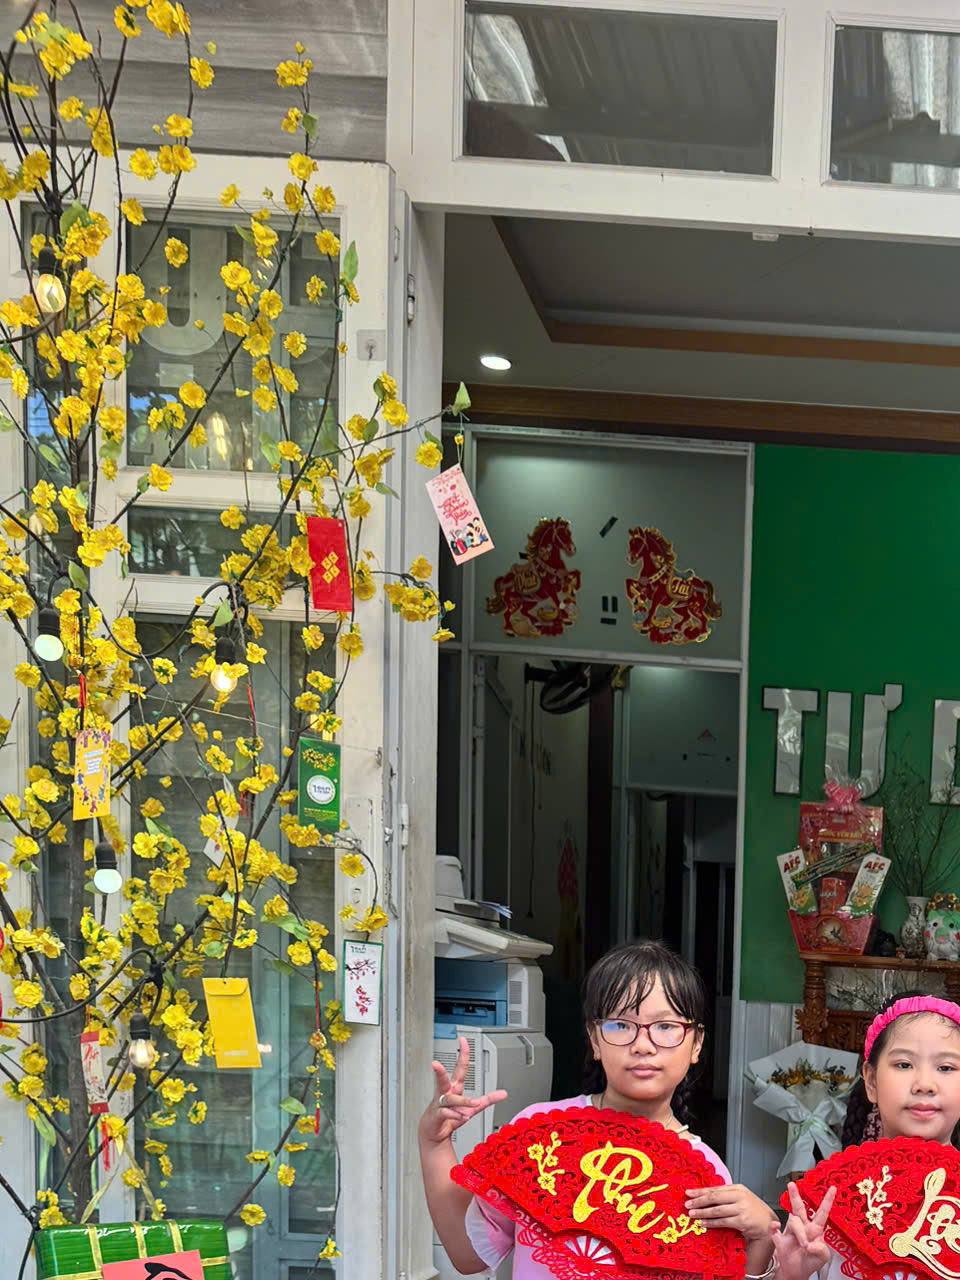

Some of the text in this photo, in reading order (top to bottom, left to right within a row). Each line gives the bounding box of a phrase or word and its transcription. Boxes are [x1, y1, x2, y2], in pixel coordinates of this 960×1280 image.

[762, 684, 903, 800] TƯ
[783, 855, 801, 873] AFC
[863, 860, 886, 871] AFC
